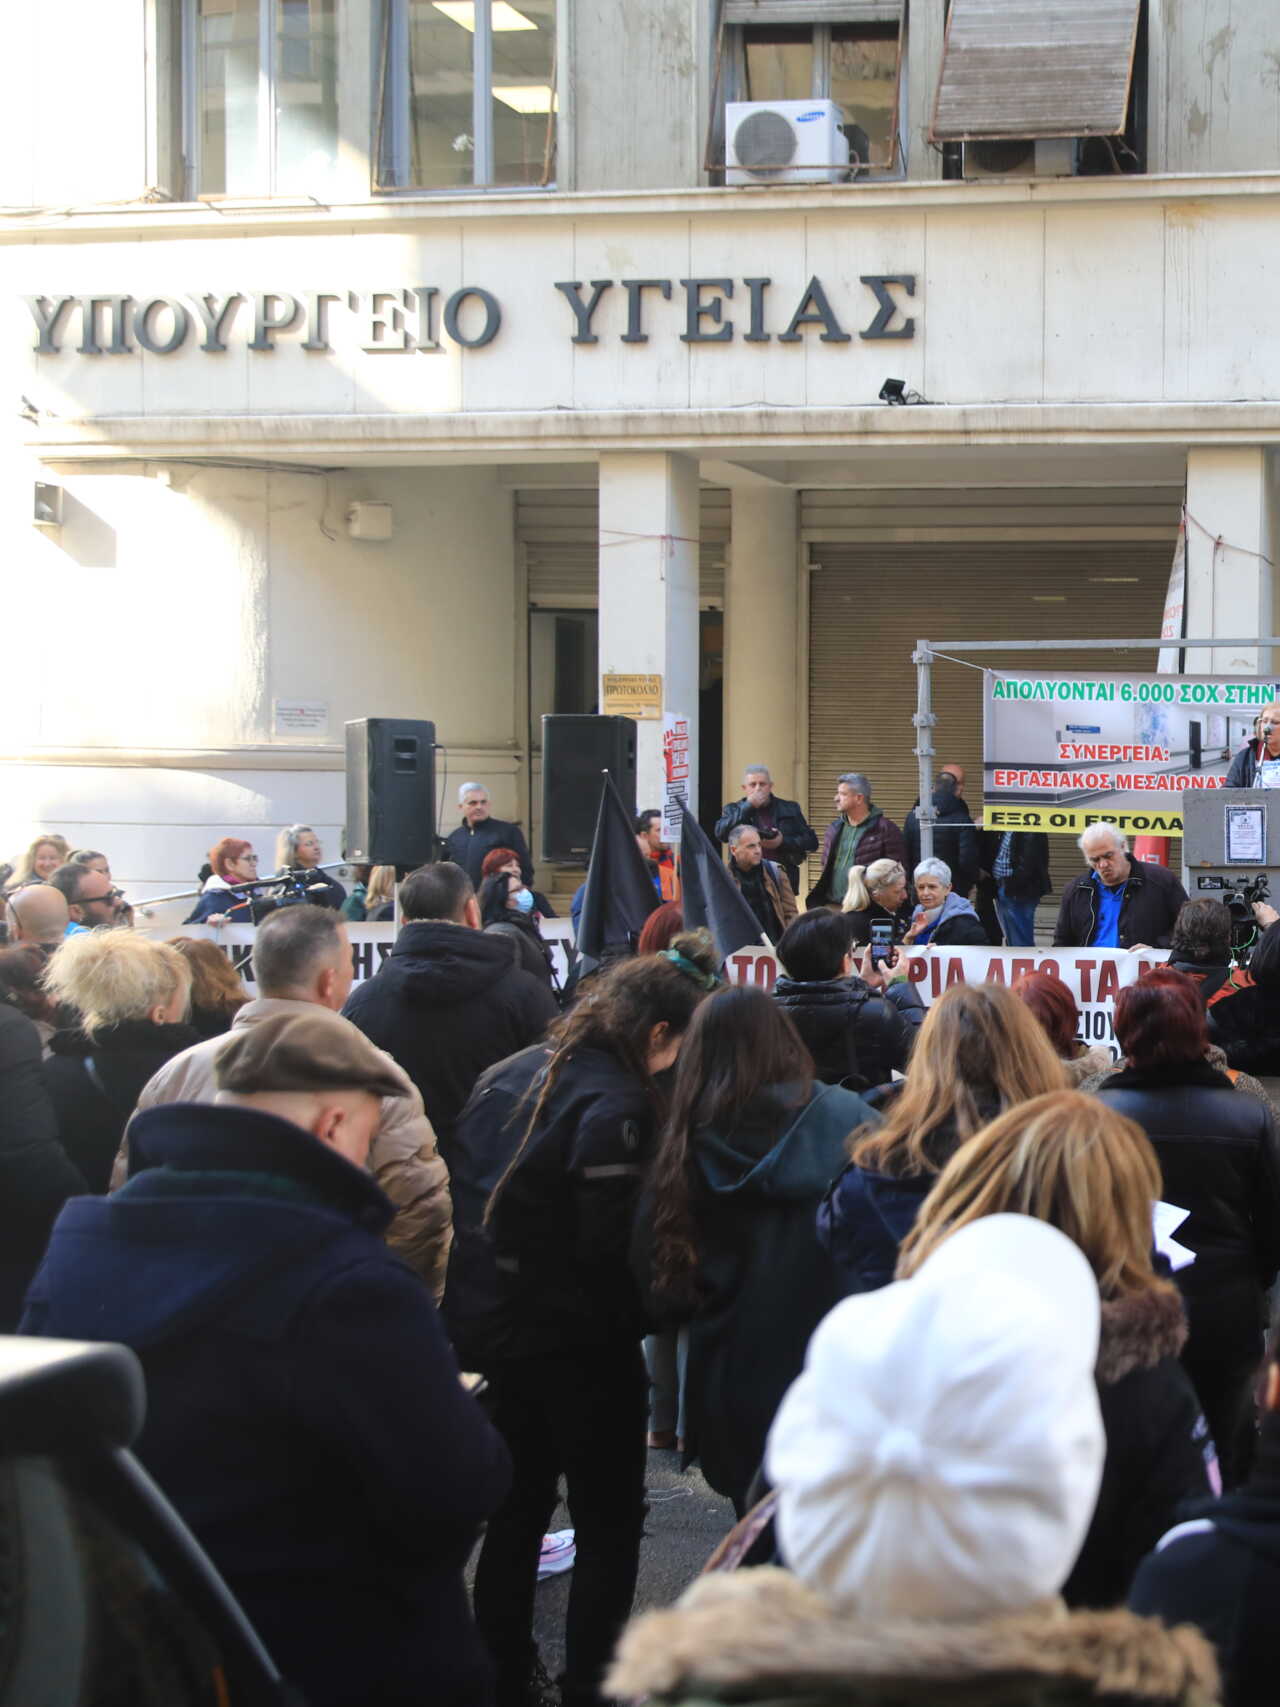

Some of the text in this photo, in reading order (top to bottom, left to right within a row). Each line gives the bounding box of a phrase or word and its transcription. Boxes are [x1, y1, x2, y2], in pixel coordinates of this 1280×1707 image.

[28, 274, 917, 353] ΥΠΟΥΡΓΕΙΟ ΥΓΕΙΑΣ
[993, 680, 1114, 702] ΑΠΟΛΥΟΝΤΑΙ
[1121, 683, 1174, 703] 6.000
[1180, 684, 1219, 703] ΣΟΧ
[1224, 685, 1274, 704] ΣΤΗΝ
[1059, 744, 1169, 761] ΣΥΝΕΡΓΕΙΑ:
[994, 770, 1111, 788] ΕΡΓΑΣΙΑΚΟΣ
[991, 812, 1183, 831] ΕΞΩ ΟΙ ΕΡΓΟΛΑ
[1075, 959, 1120, 1003] ΤΑ
